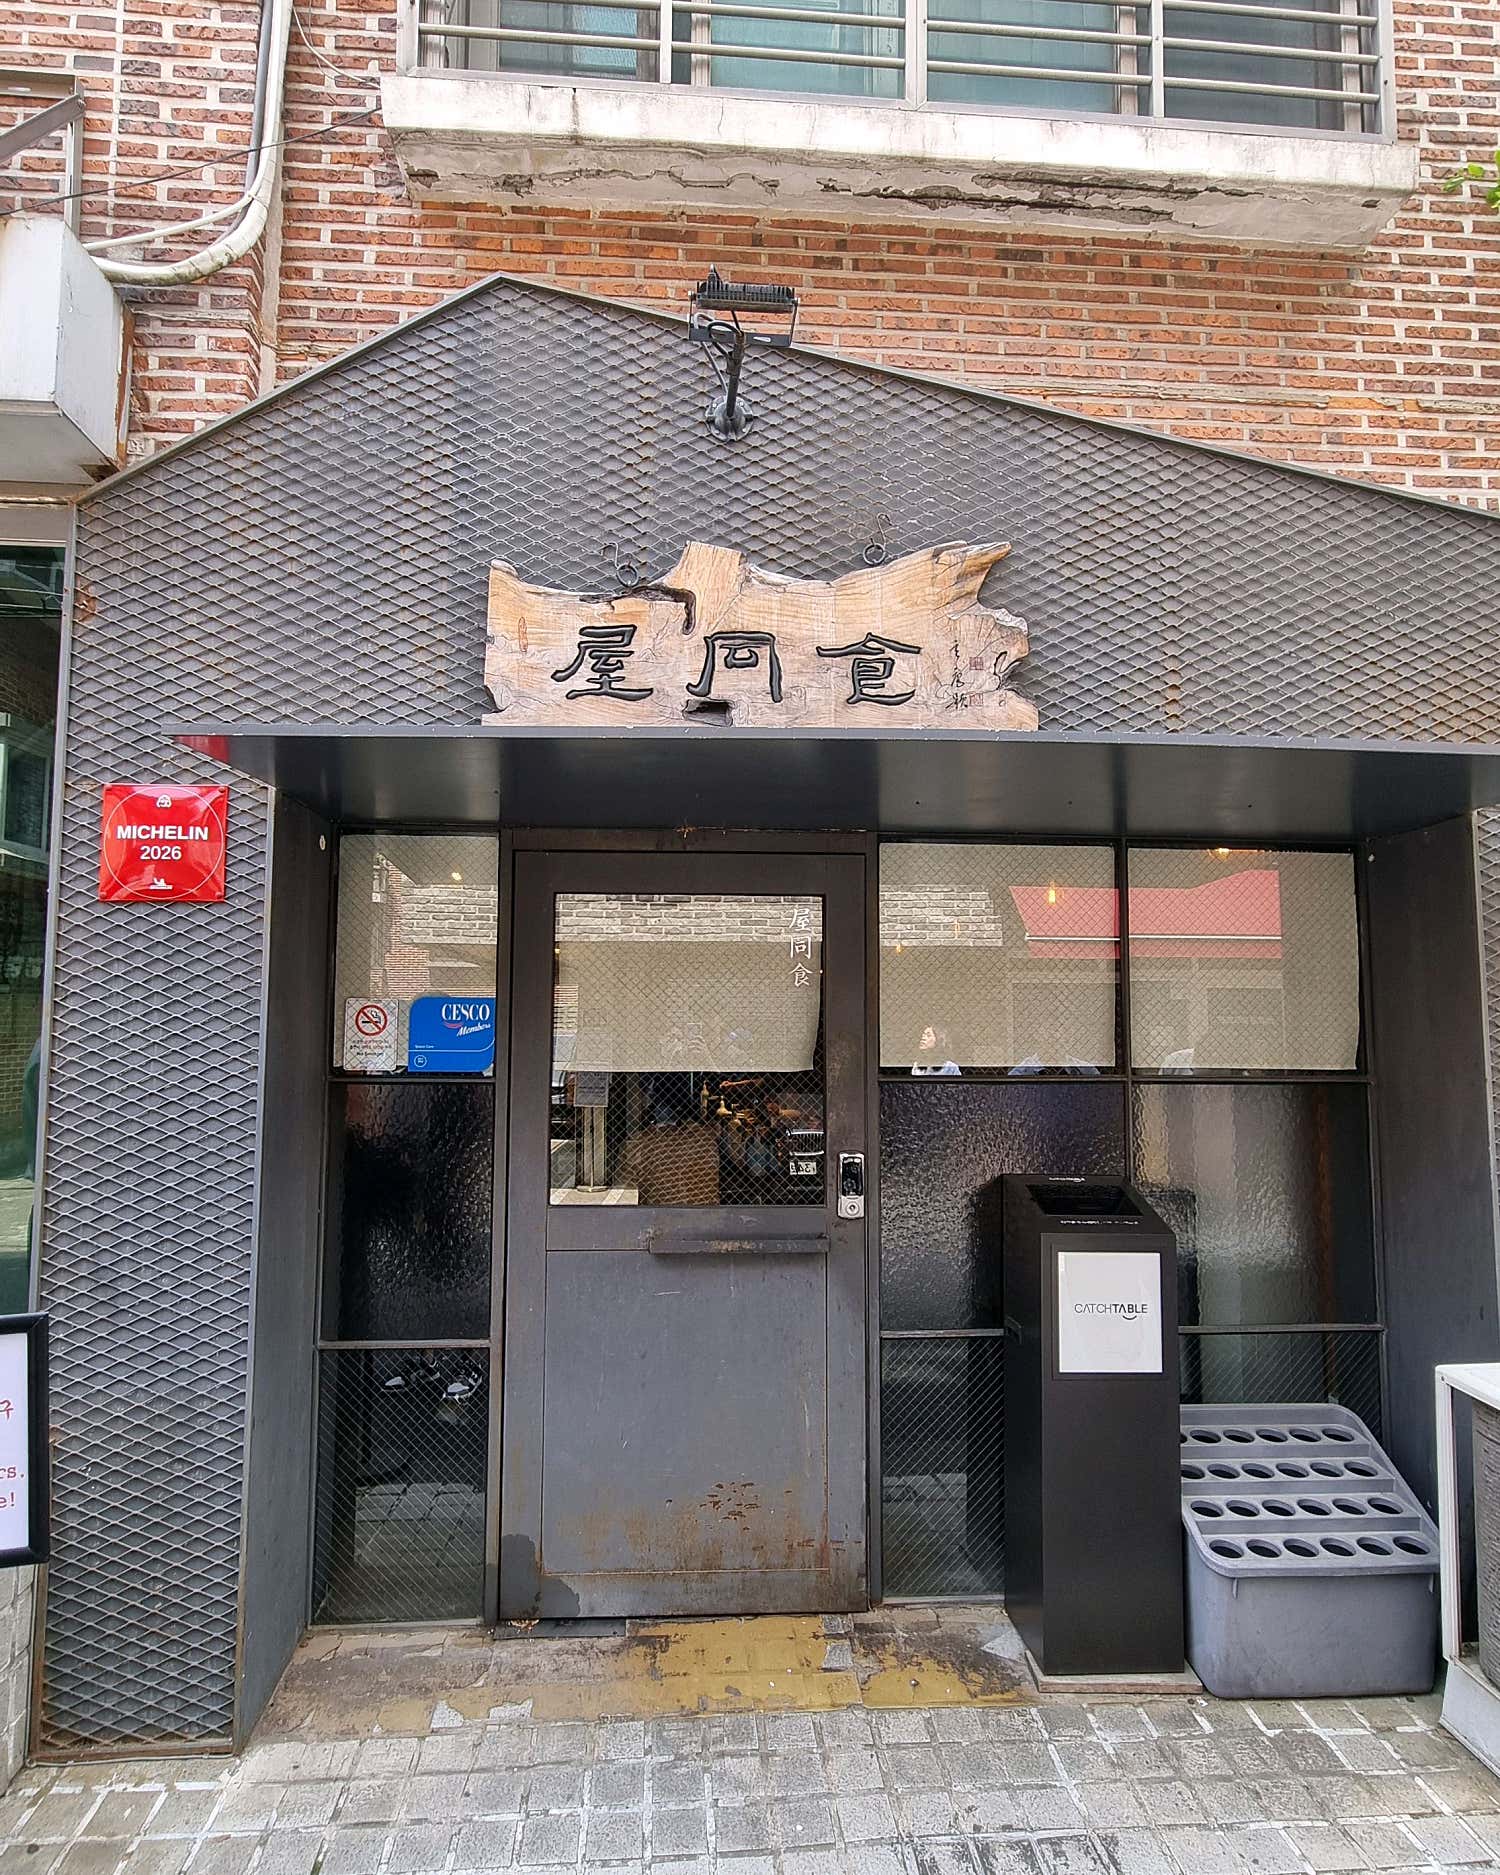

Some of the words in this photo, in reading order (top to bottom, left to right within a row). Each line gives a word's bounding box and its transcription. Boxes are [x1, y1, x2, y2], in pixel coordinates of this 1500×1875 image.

[116, 825, 208, 841] MICHELIN
[139, 845, 182, 860] 2026
[788, 908, 814, 987] 屋同食
[441, 1003, 491, 1021] CESCO
[456, 1022, 491, 1037] Members
[1074, 1303, 1149, 1314] CATCHTABLE
